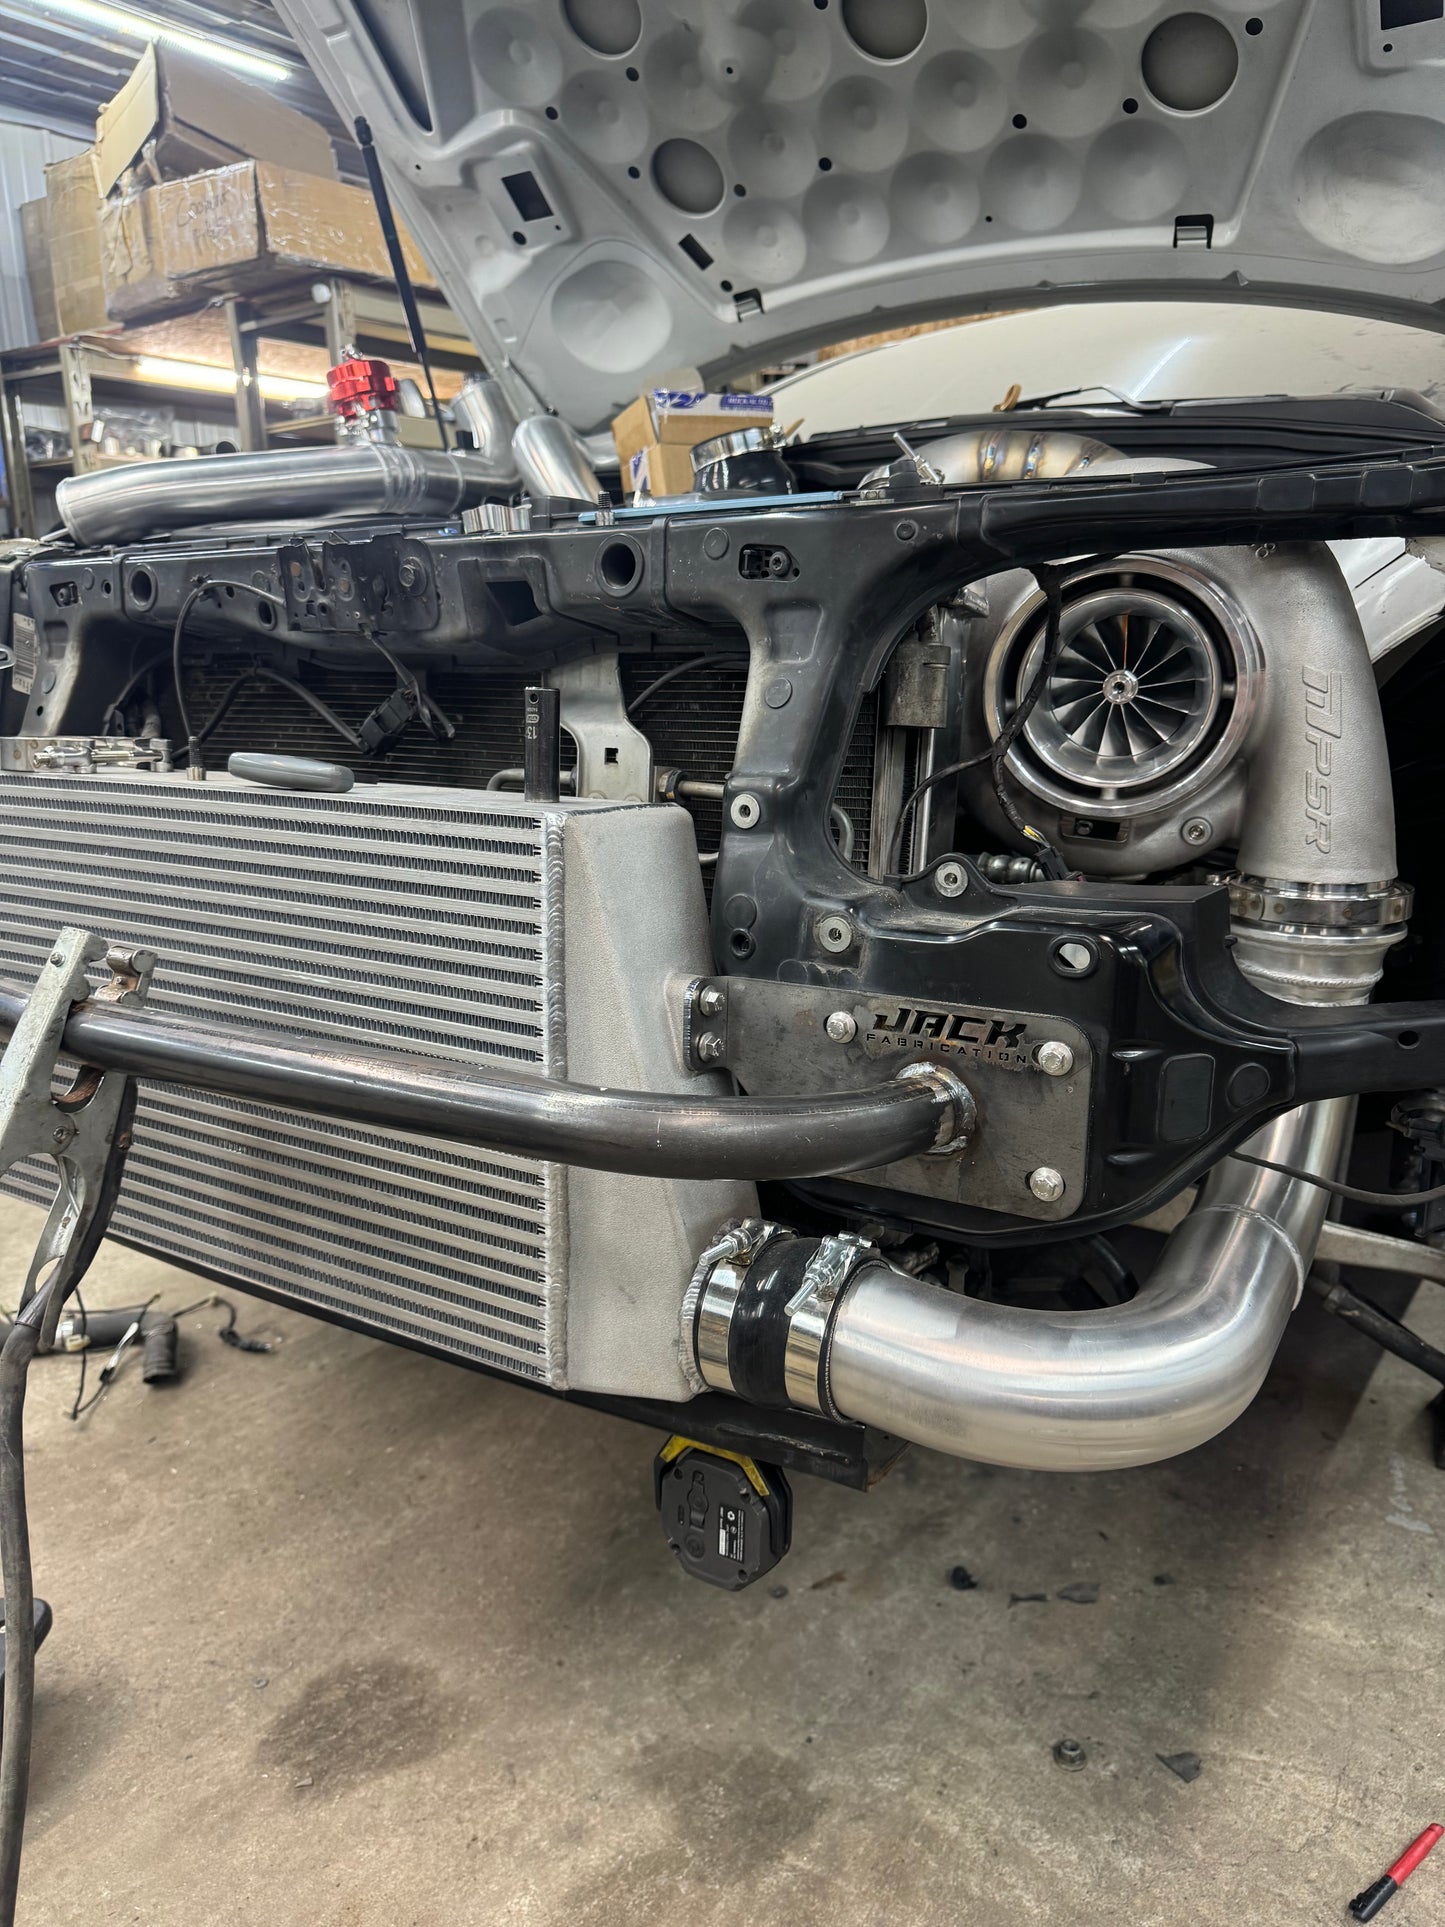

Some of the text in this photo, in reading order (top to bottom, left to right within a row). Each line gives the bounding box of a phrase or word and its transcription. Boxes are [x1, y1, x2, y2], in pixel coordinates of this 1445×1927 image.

[527, 726, 537, 739] 13
[872, 1007, 1027, 1048] JACK
[866, 1033, 1027, 1064] FABRICATION
